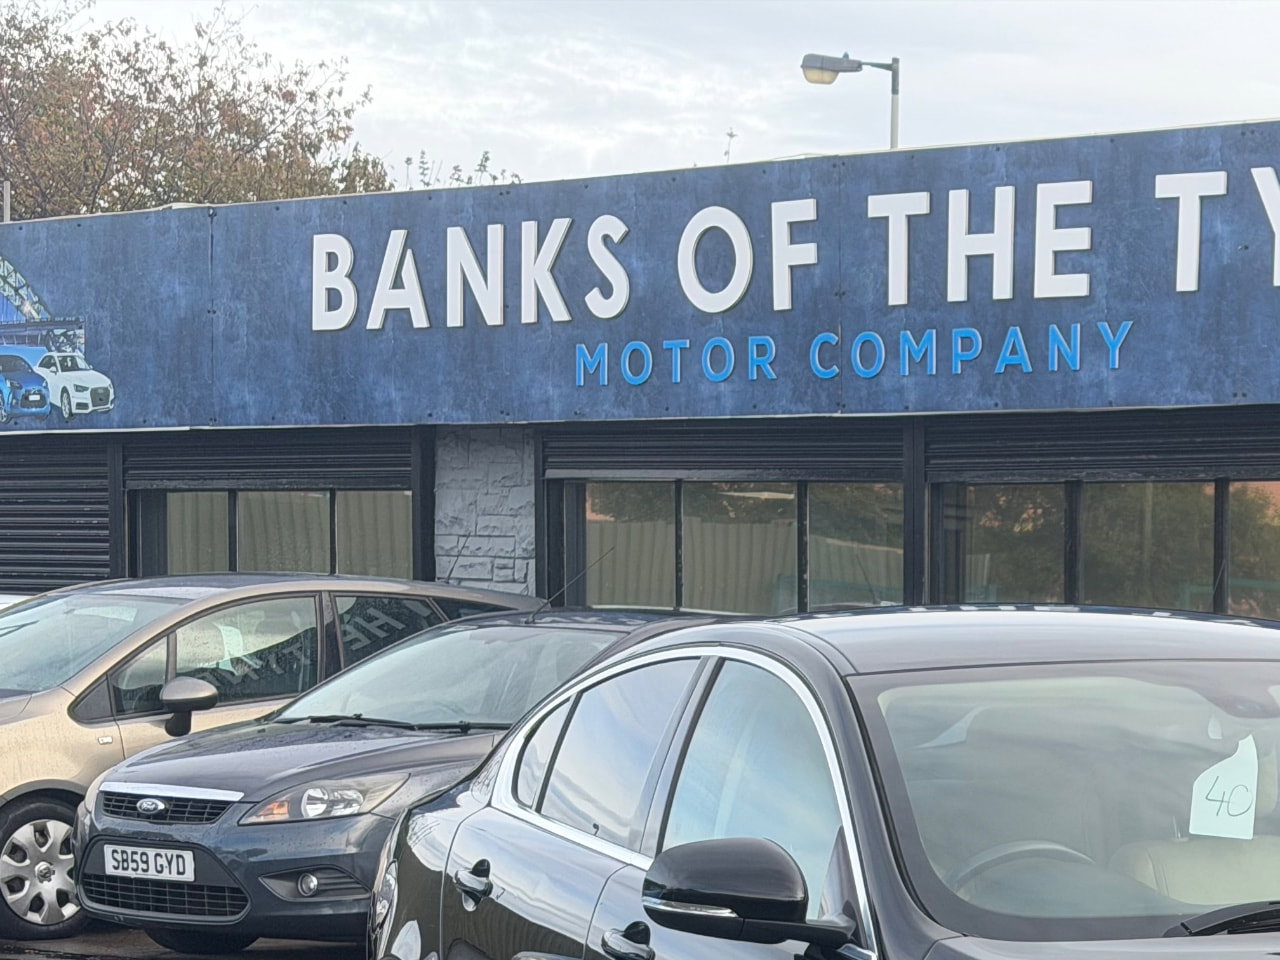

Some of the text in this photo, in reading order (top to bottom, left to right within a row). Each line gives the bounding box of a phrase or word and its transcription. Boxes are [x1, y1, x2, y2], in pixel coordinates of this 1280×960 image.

[310, 213, 630, 331] BANKS
[677, 197, 818, 314] OF
[867, 179, 1094, 307] THE
[575, 319, 1135, 388] MOTOR COMPANY
[1205, 775, 1254, 817] 40
[111, 848, 186, 877] SB59 GYD
